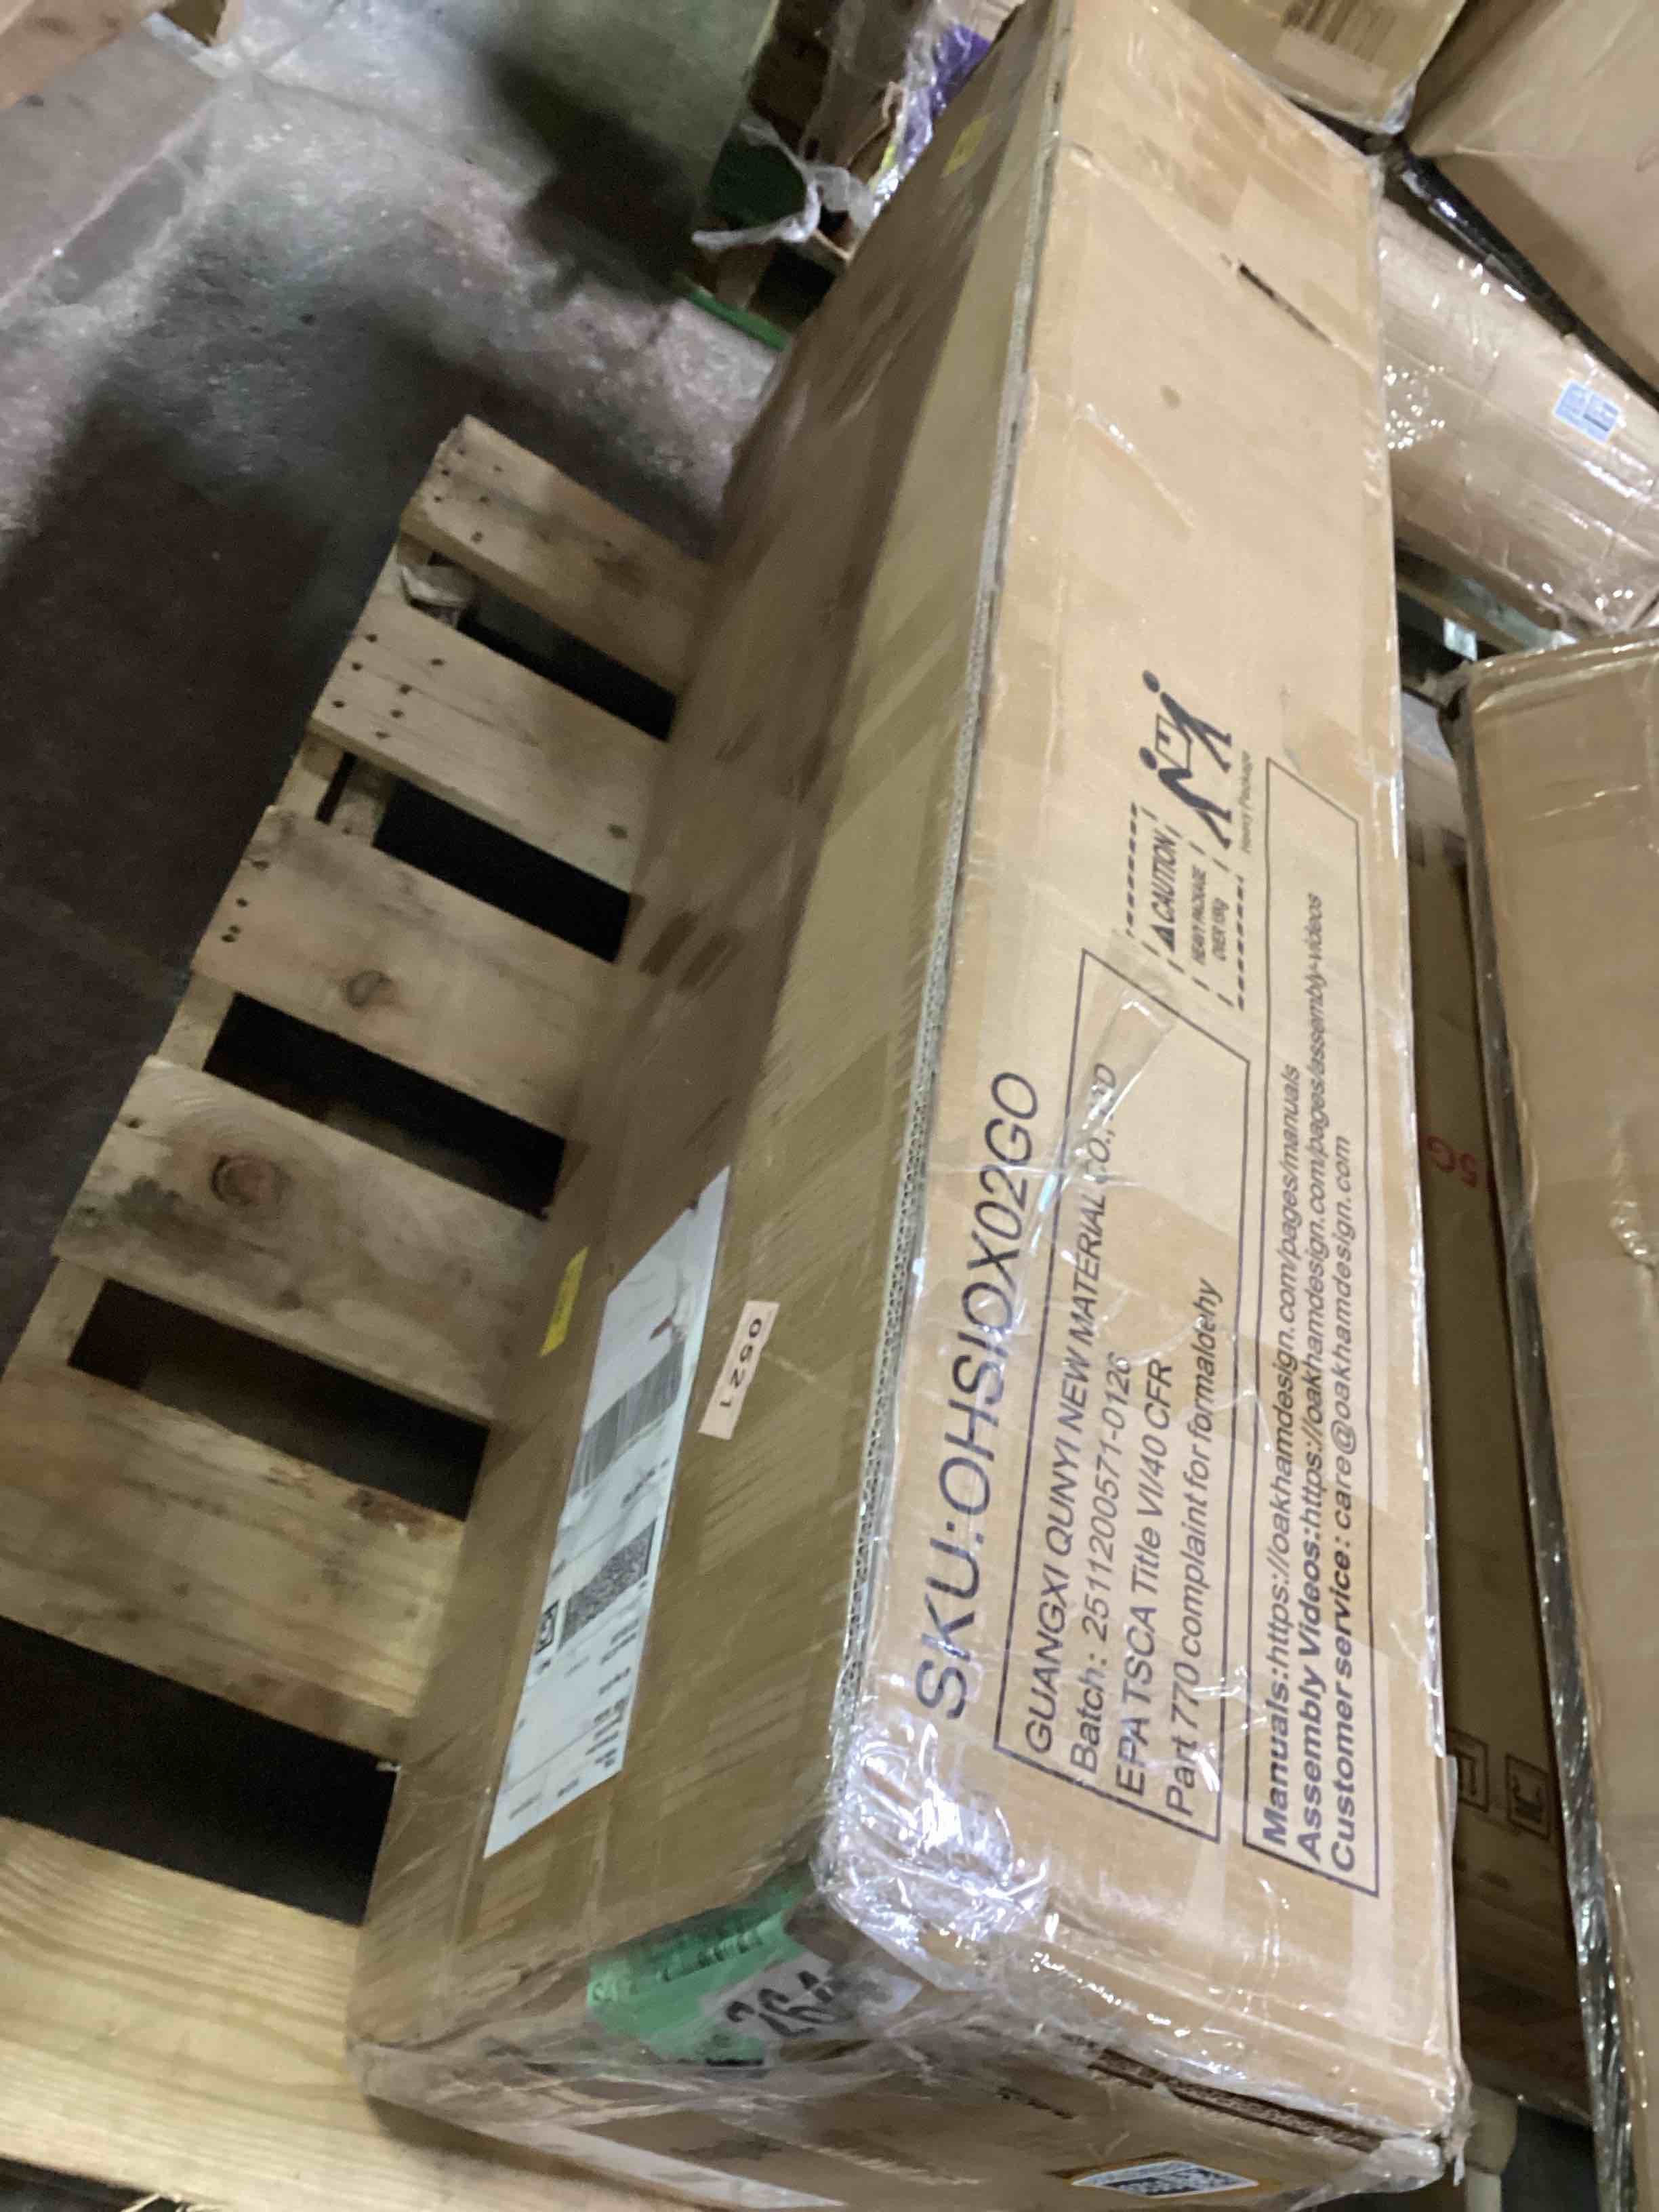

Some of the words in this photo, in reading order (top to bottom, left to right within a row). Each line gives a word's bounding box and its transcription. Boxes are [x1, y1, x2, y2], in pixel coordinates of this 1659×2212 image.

[1151, 828, 1176, 924] CAUTION
[1070, 1191, 1105, 1349] MATERIAL
[1059, 1351, 1093, 1435] NEW
[1144, 1359, 1173, 1432] CFR
[1187, 1278, 1223, 1445] formaldehy
[1046, 1441, 1082, 1557] QUNYI
[1137, 1434, 1167, 1518] VI/40
[1187, 1444, 1211, 1491] for
[1131, 1526, 1162, 1604] Title
[1179, 1495, 1211, 1662] complaint
[1025, 1566, 1069, 1754] GUANGXI
[1123, 1605, 1156, 1704] TSCA
[1172, 1662, 1200, 1740] 770
[1116, 1715, 1150, 1796] EPA
[1166, 1741, 1195, 1817] Part
[1297, 1664, 1327, 1862] Assembly
[1330, 1678, 1355, 1872] Customer
